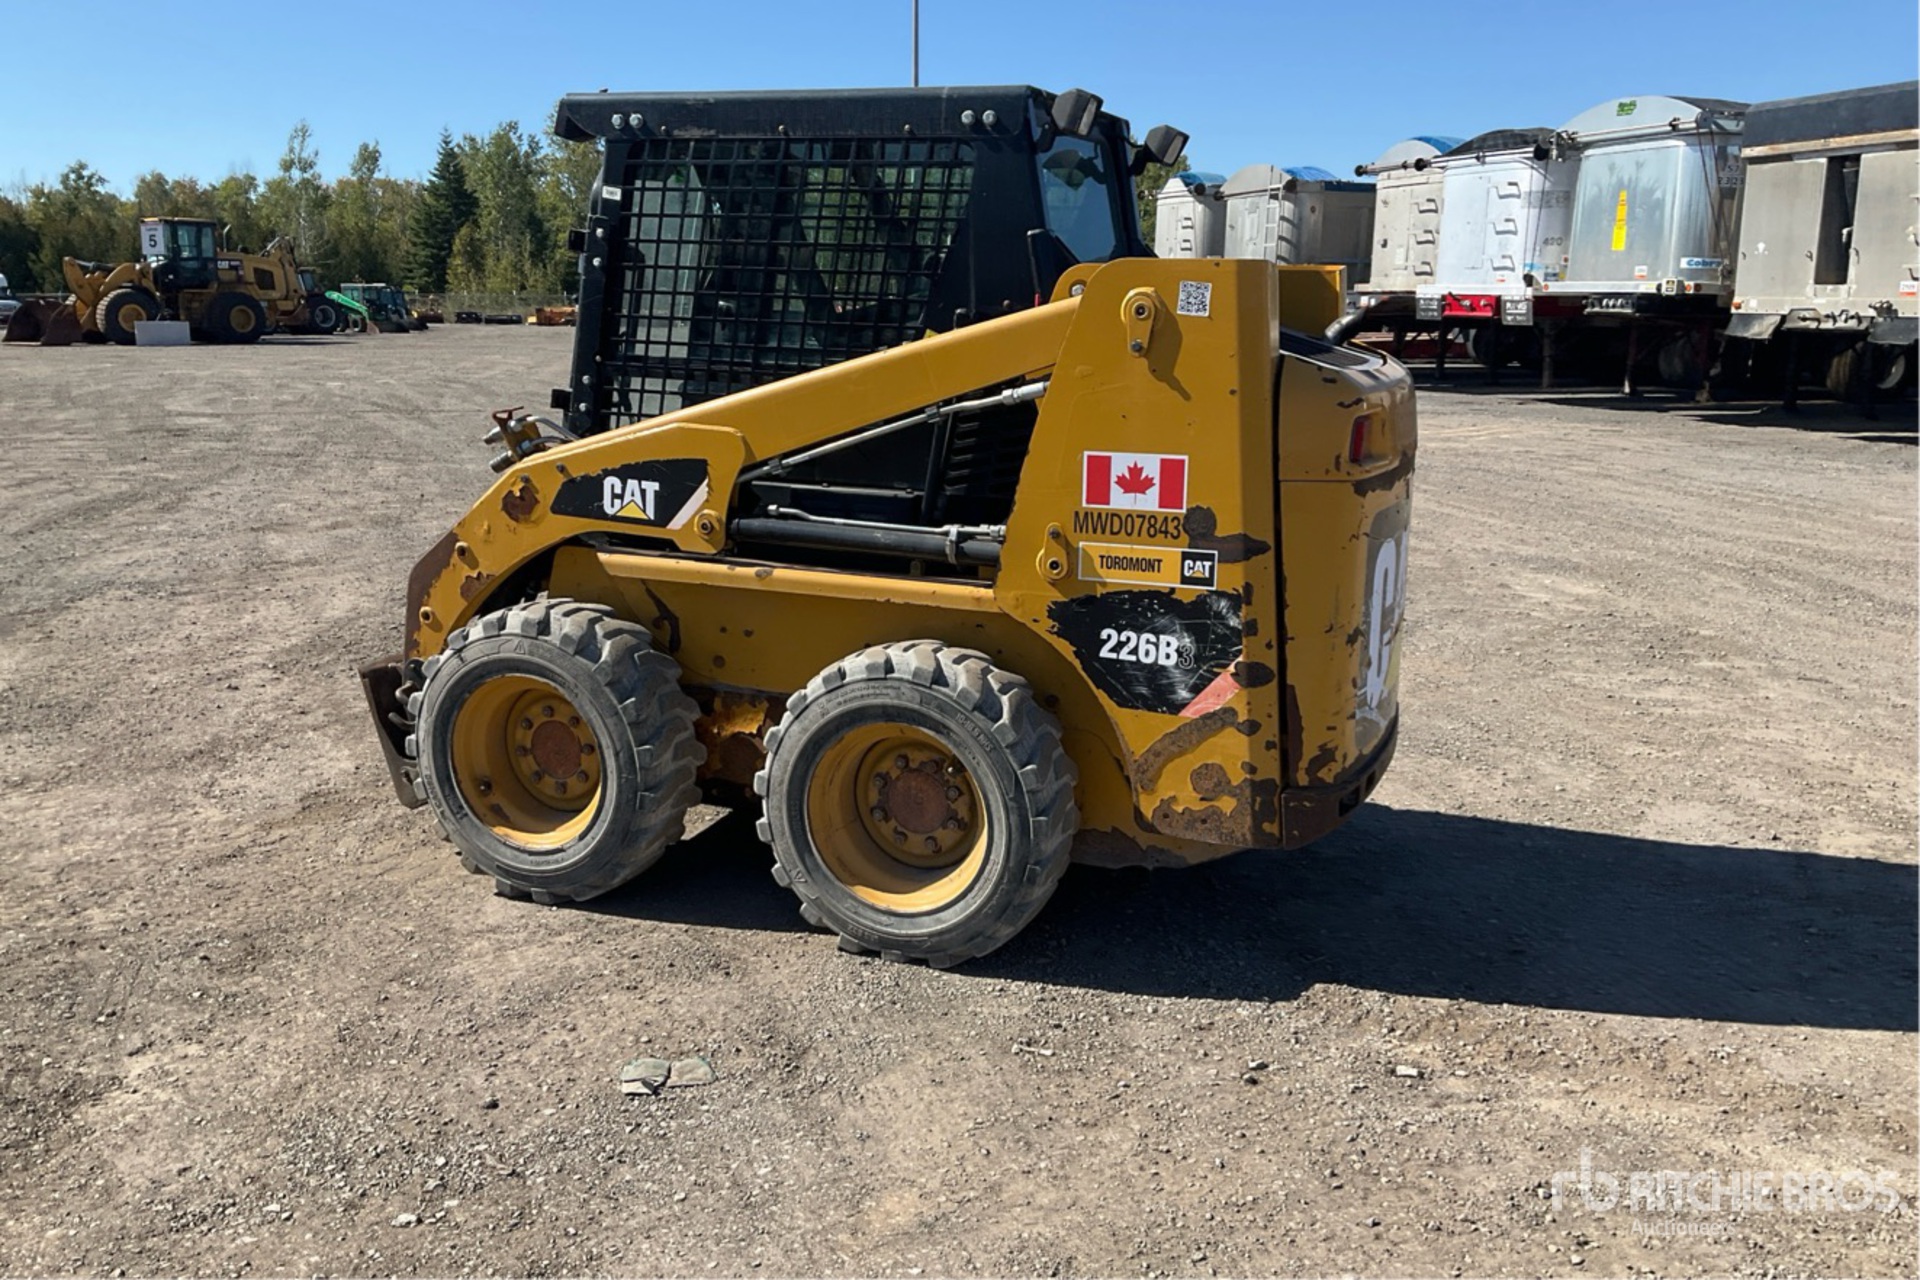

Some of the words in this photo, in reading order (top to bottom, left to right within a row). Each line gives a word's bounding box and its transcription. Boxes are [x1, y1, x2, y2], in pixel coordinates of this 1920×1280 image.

[148, 234, 158, 248] 5
[603, 475, 660, 520] CAT
[1073, 510, 1182, 540] MWD07843
[1098, 554, 1163, 574] TOROMONT
[1183, 559, 1214, 579] CAT
